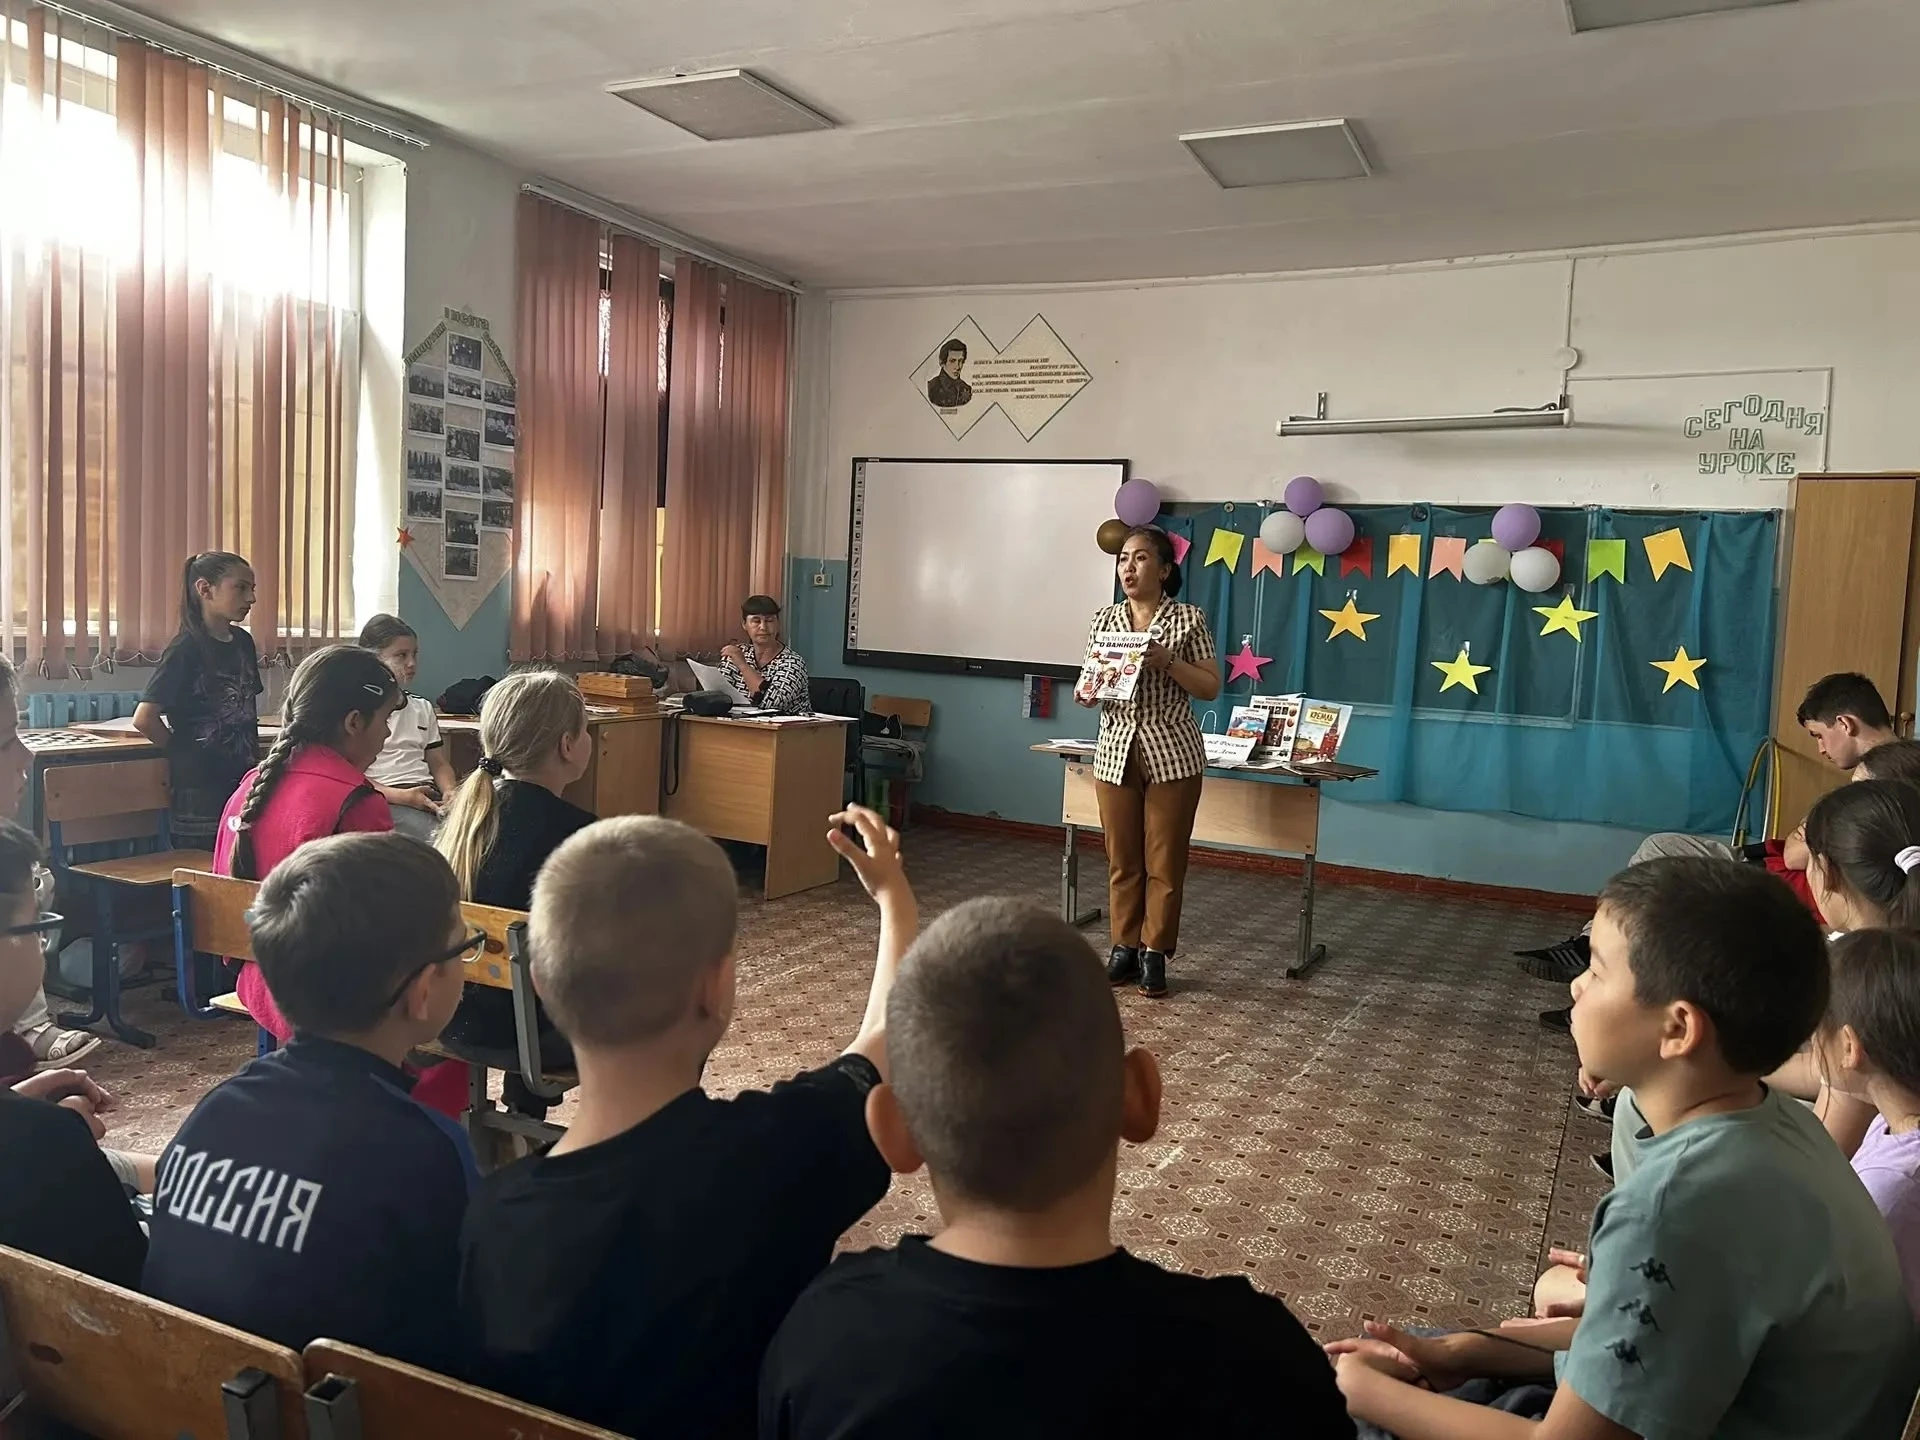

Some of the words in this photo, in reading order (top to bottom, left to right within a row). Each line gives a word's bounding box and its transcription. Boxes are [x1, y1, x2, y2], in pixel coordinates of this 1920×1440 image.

[1684, 394, 1824, 438] СЕГОДНЯ
[1729, 428, 1764, 450] НА
[1699, 452, 1796, 475] УРОКЕ
[1310, 711, 1333, 721] КРЕМЛЬ
[156, 1144, 323, 1253] РОССИЯ
